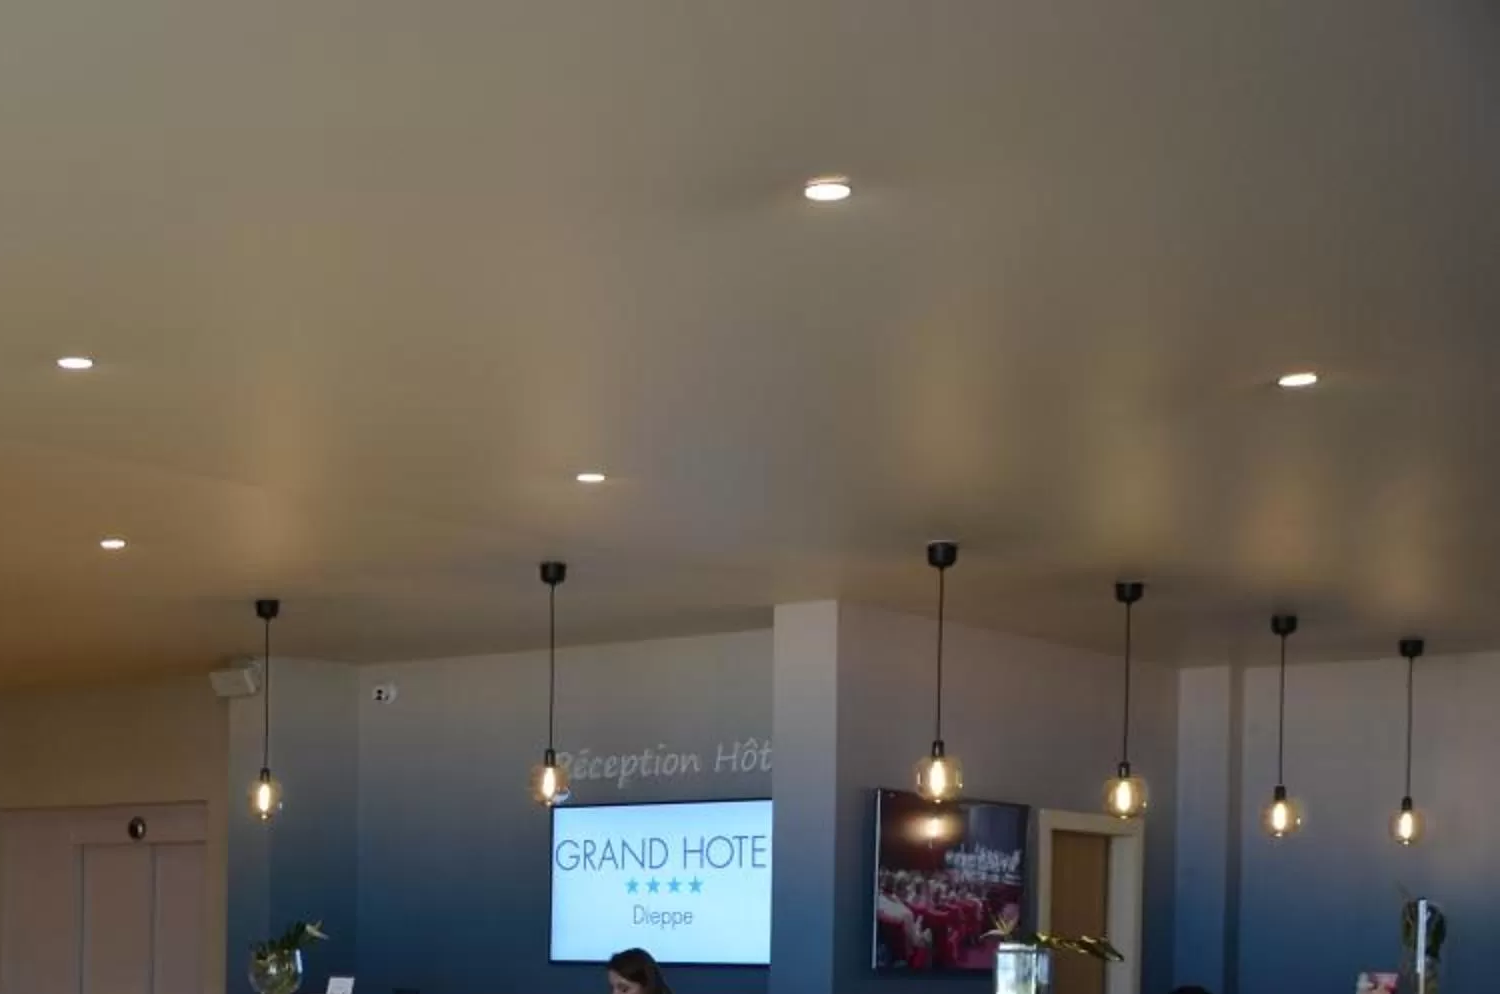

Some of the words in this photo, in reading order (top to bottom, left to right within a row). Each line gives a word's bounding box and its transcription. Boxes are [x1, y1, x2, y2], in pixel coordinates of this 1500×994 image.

[555, 744, 700, 788] Réception
[713, 736, 772, 773] Hôt
[555, 836, 669, 871] GRAND
[683, 835, 767, 869] HOTE
[632, 904, 694, 929] Dieppe
